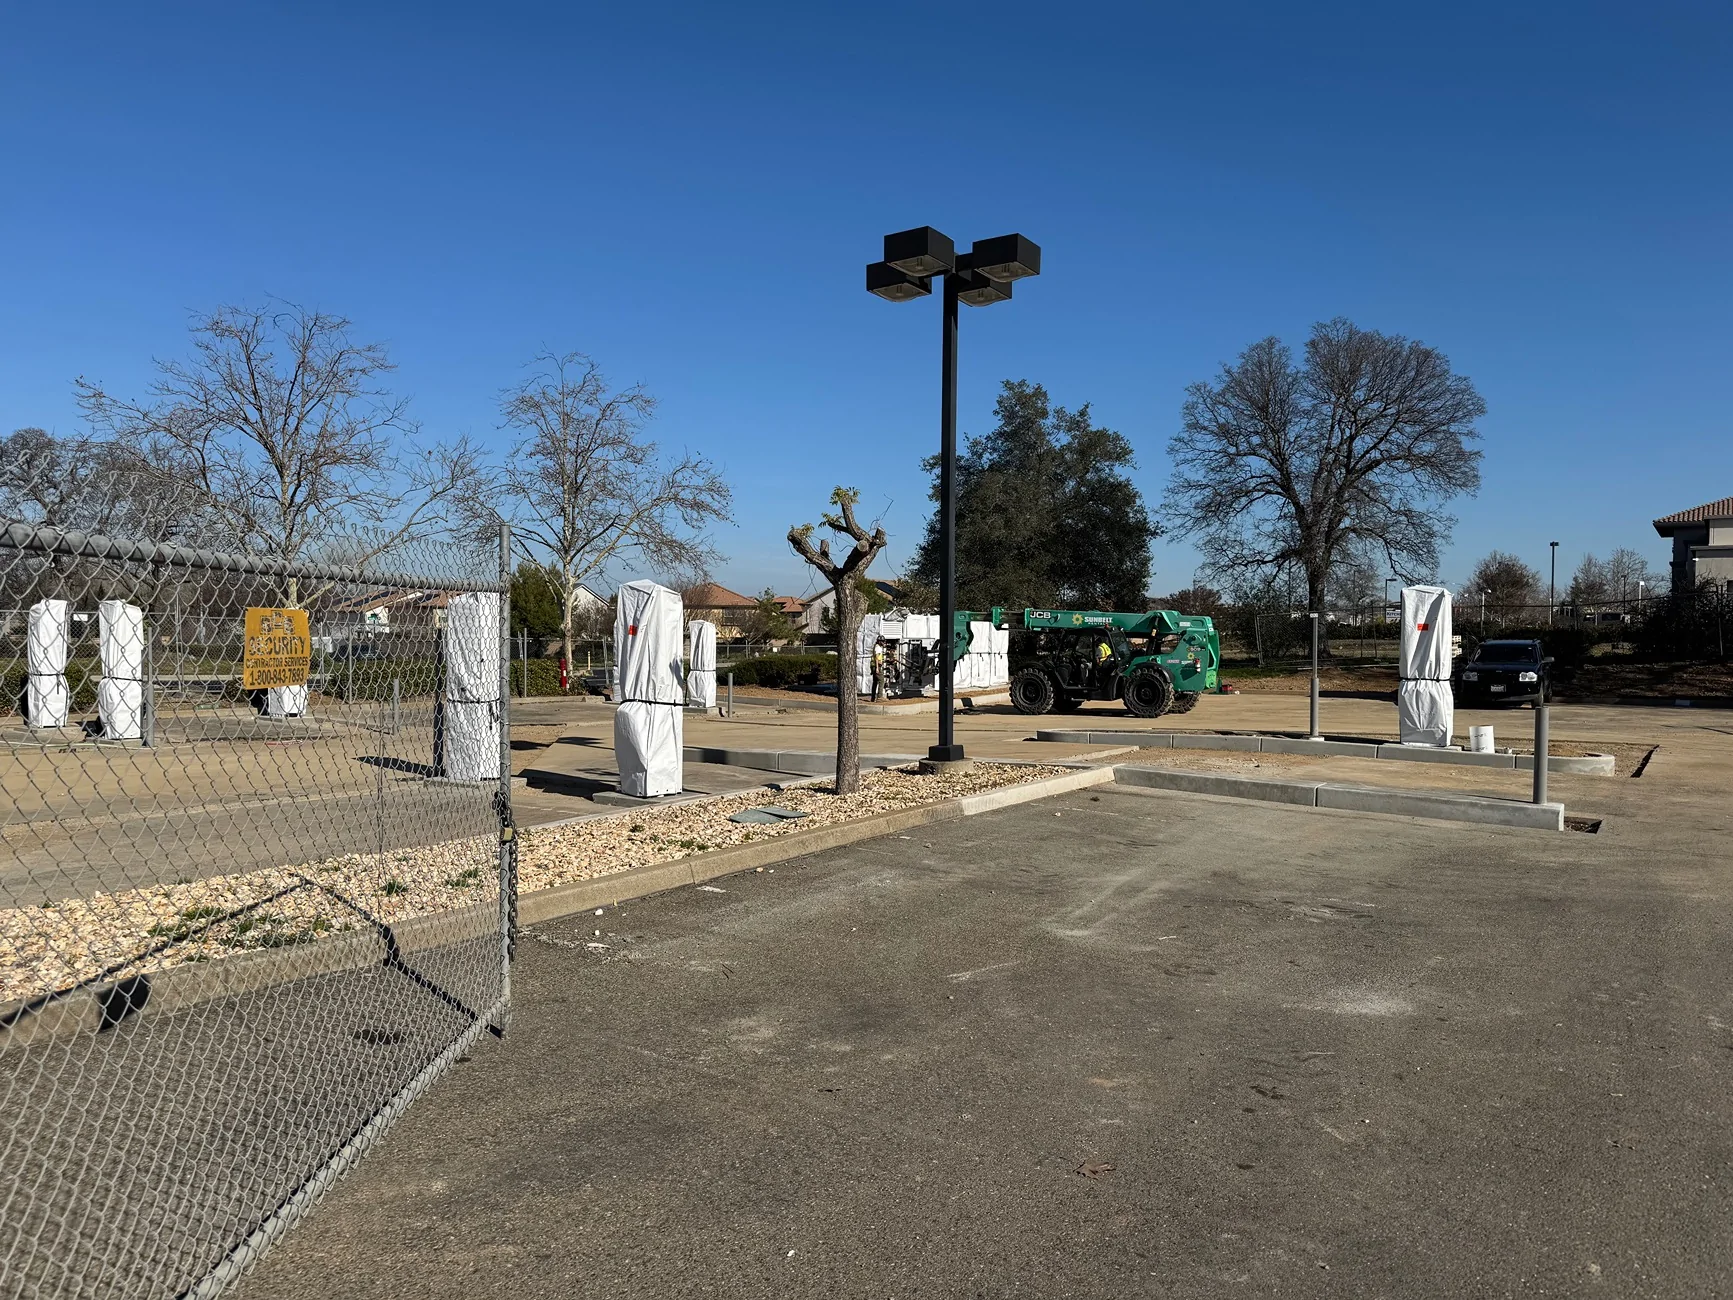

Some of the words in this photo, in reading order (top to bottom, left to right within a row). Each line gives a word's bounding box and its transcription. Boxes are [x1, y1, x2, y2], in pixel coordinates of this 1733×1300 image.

[1030, 611, 1051, 619] JCB
[249, 636, 306, 656] SECURITY
[246, 657, 283, 668] CONTRACTOR
[284, 656, 308, 667] SERVICES
[249, 668, 305, 686] 1-800-843-7893
